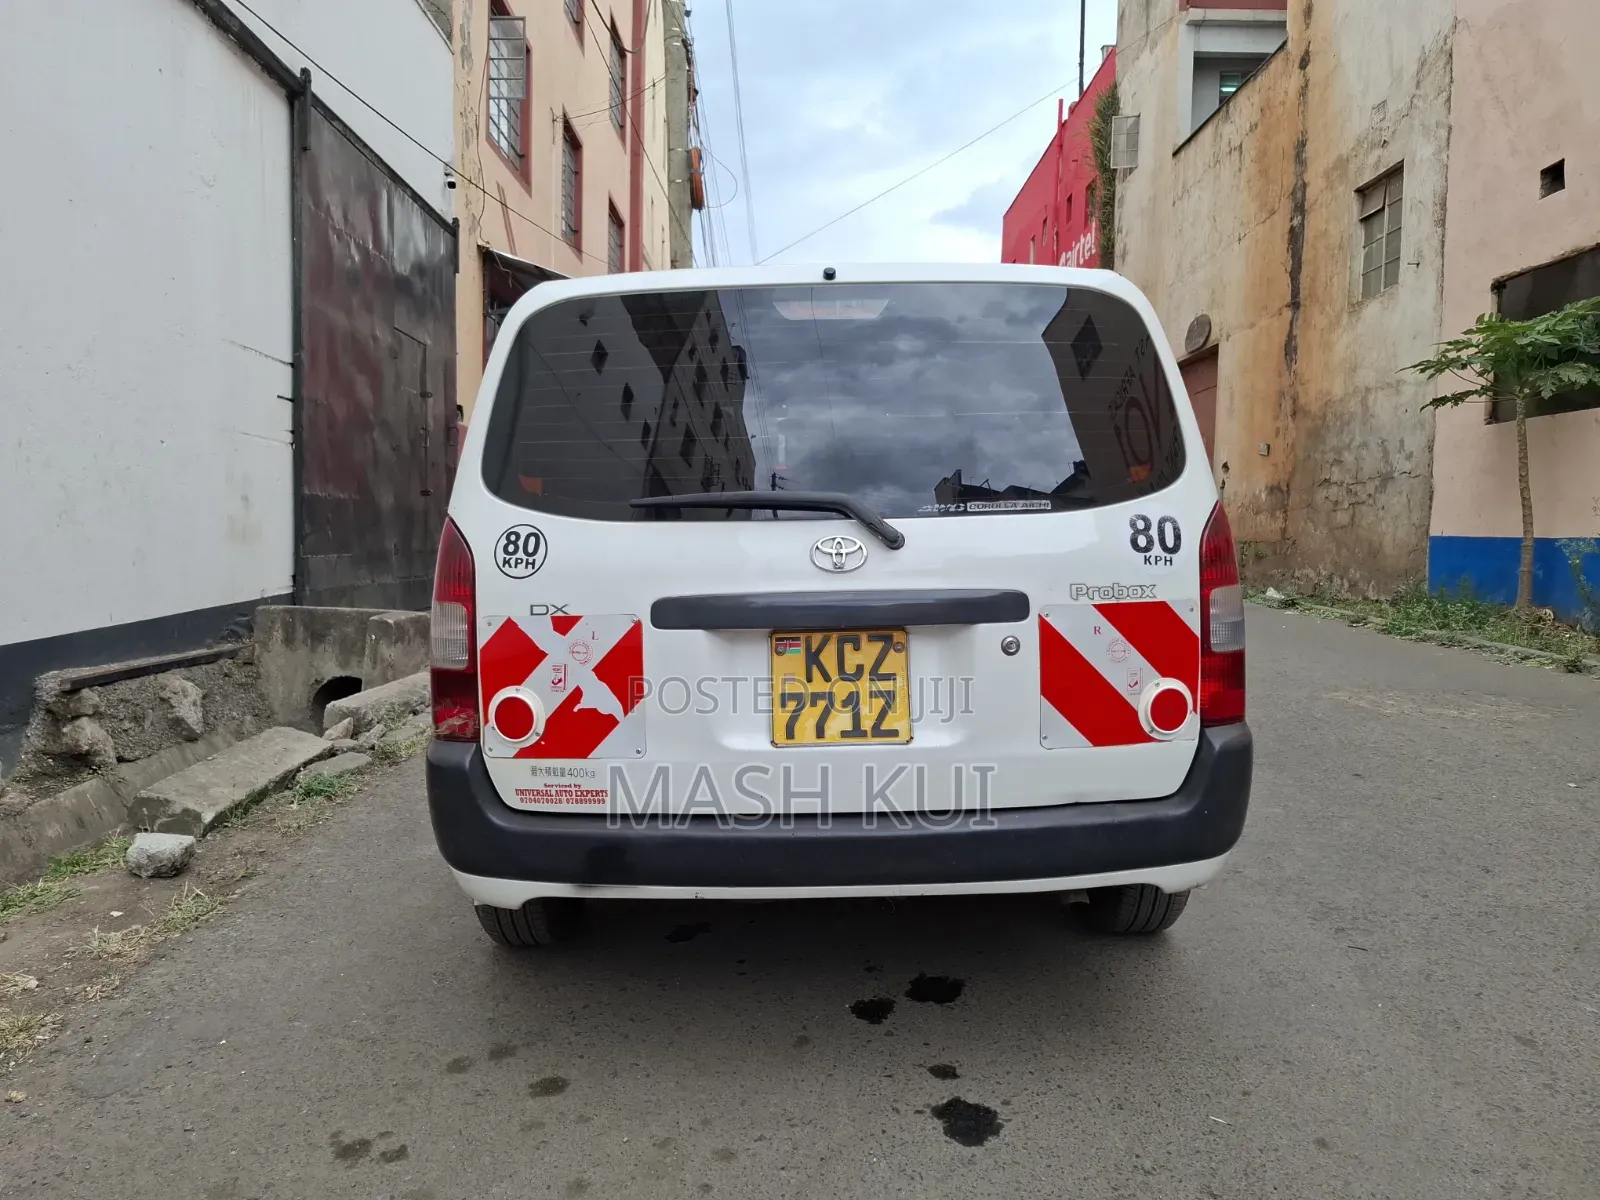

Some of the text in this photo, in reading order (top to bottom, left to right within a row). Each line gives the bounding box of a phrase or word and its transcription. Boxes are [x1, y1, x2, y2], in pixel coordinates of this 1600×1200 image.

[969, 501, 1018, 510] COROLLA
[1020, 500, 1050, 509] AICHI
[1129, 513, 1182, 555] 80
[502, 530, 541, 557] 80
[502, 557, 536, 570] KPH
[1144, 555, 1173, 567] KPH
[1069, 583, 1157, 601] Probox
[529, 604, 570, 616] DX
[591, 630, 599, 641] L
[1093, 625, 1102, 635] R
[805, 635, 897, 683] KCZ
[515, 788, 608, 798] UNIVERSAL AUTO EXPERTS
